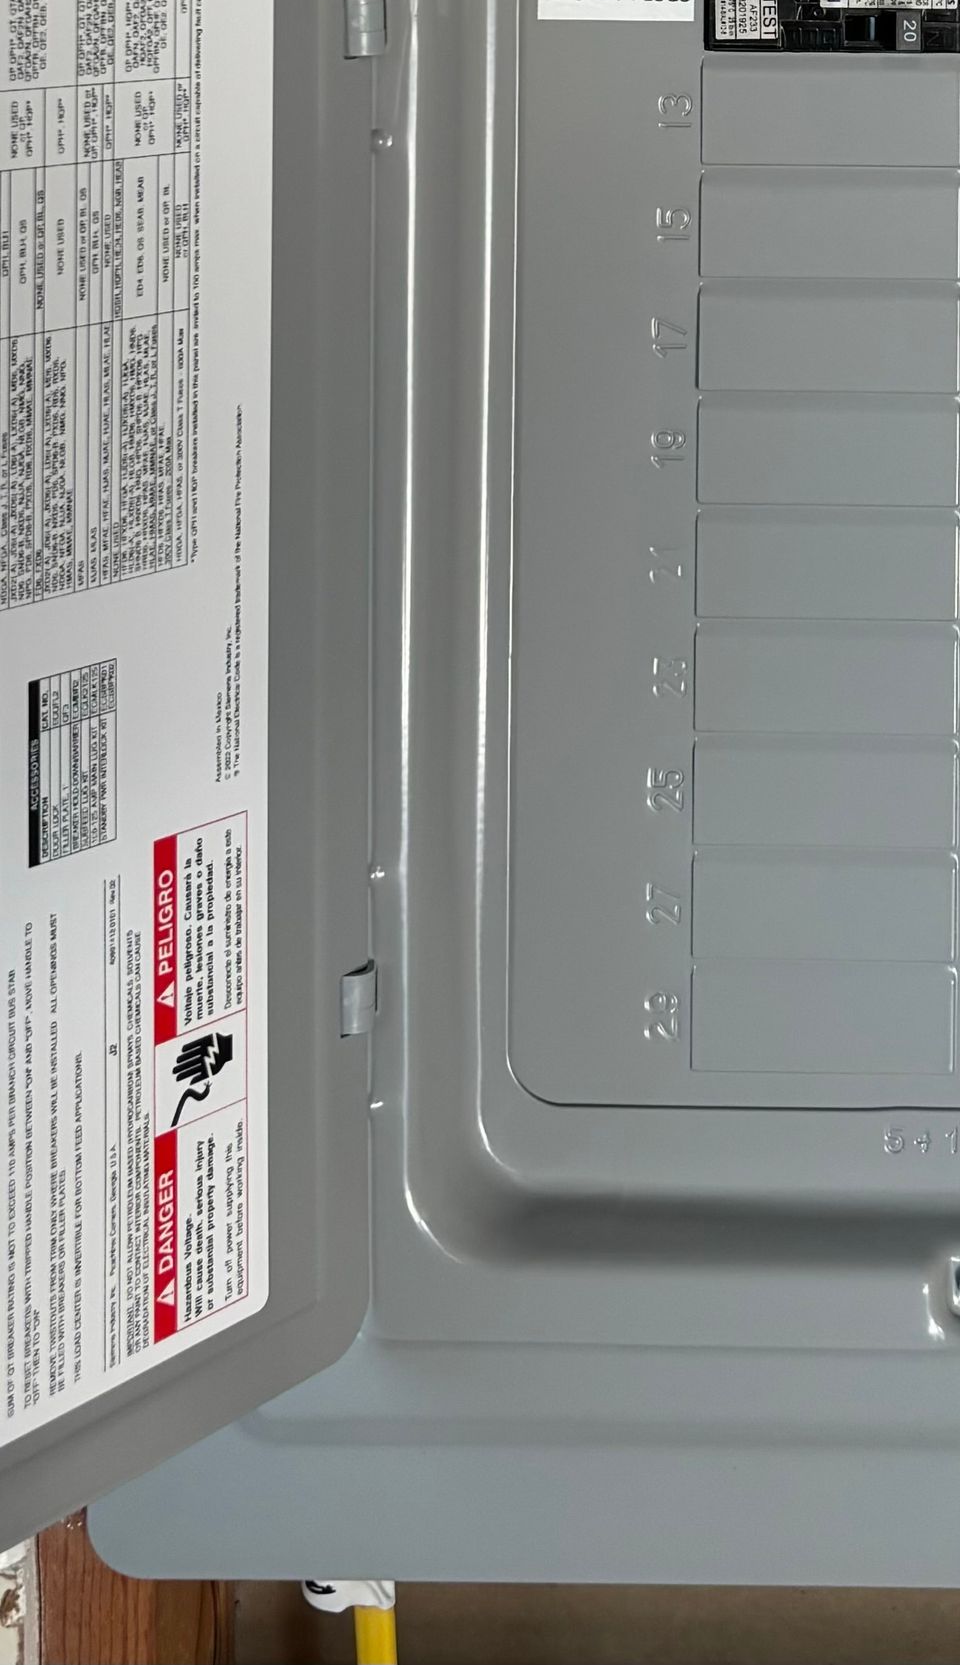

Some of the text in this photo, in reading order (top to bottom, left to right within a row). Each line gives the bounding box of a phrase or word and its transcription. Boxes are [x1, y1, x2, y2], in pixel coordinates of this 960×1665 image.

[903, 20, 917, 42] 20
[658, 93, 693, 128] 13
[656, 207, 691, 243] 15
[651, 316, 688, 358] 17
[650, 427, 686, 468] 19
[31, 739, 39, 811] ACCESSORIES
[647, 767, 684, 813] 25
[194, 837, 203, 866] daño
[196, 883, 204, 921] graves
[206, 860, 214, 921] propiedad.
[646, 881, 682, 926] 27
[158, 869, 174, 976] PELIGRO
[183, 858, 193, 1026] Voltaje peligroso. Causará la
[206, 925, 213, 936] la
[195, 925, 203, 973] lesiones
[206, 951, 214, 1016] substancial
[644, 993, 680, 1042] 29
[195, 1140, 204, 1172] injury
[225, 1143, 233, 1163] this
[195, 1175, 203, 1216] serious
[225, 1166, 234, 1217] supplying
[236, 1156, 244, 1198] working
[158, 1169, 174, 1275] DANGER
[206, 1133, 215, 1311] or substantial property damage.
[184, 1213, 193, 1323] Hazardous Voltage.
[225, 1259, 233, 1273] off
[236, 1240, 244, 1295] equipment
[195, 1294, 203, 1317] Will
[225, 1278, 233, 1301] Turn
